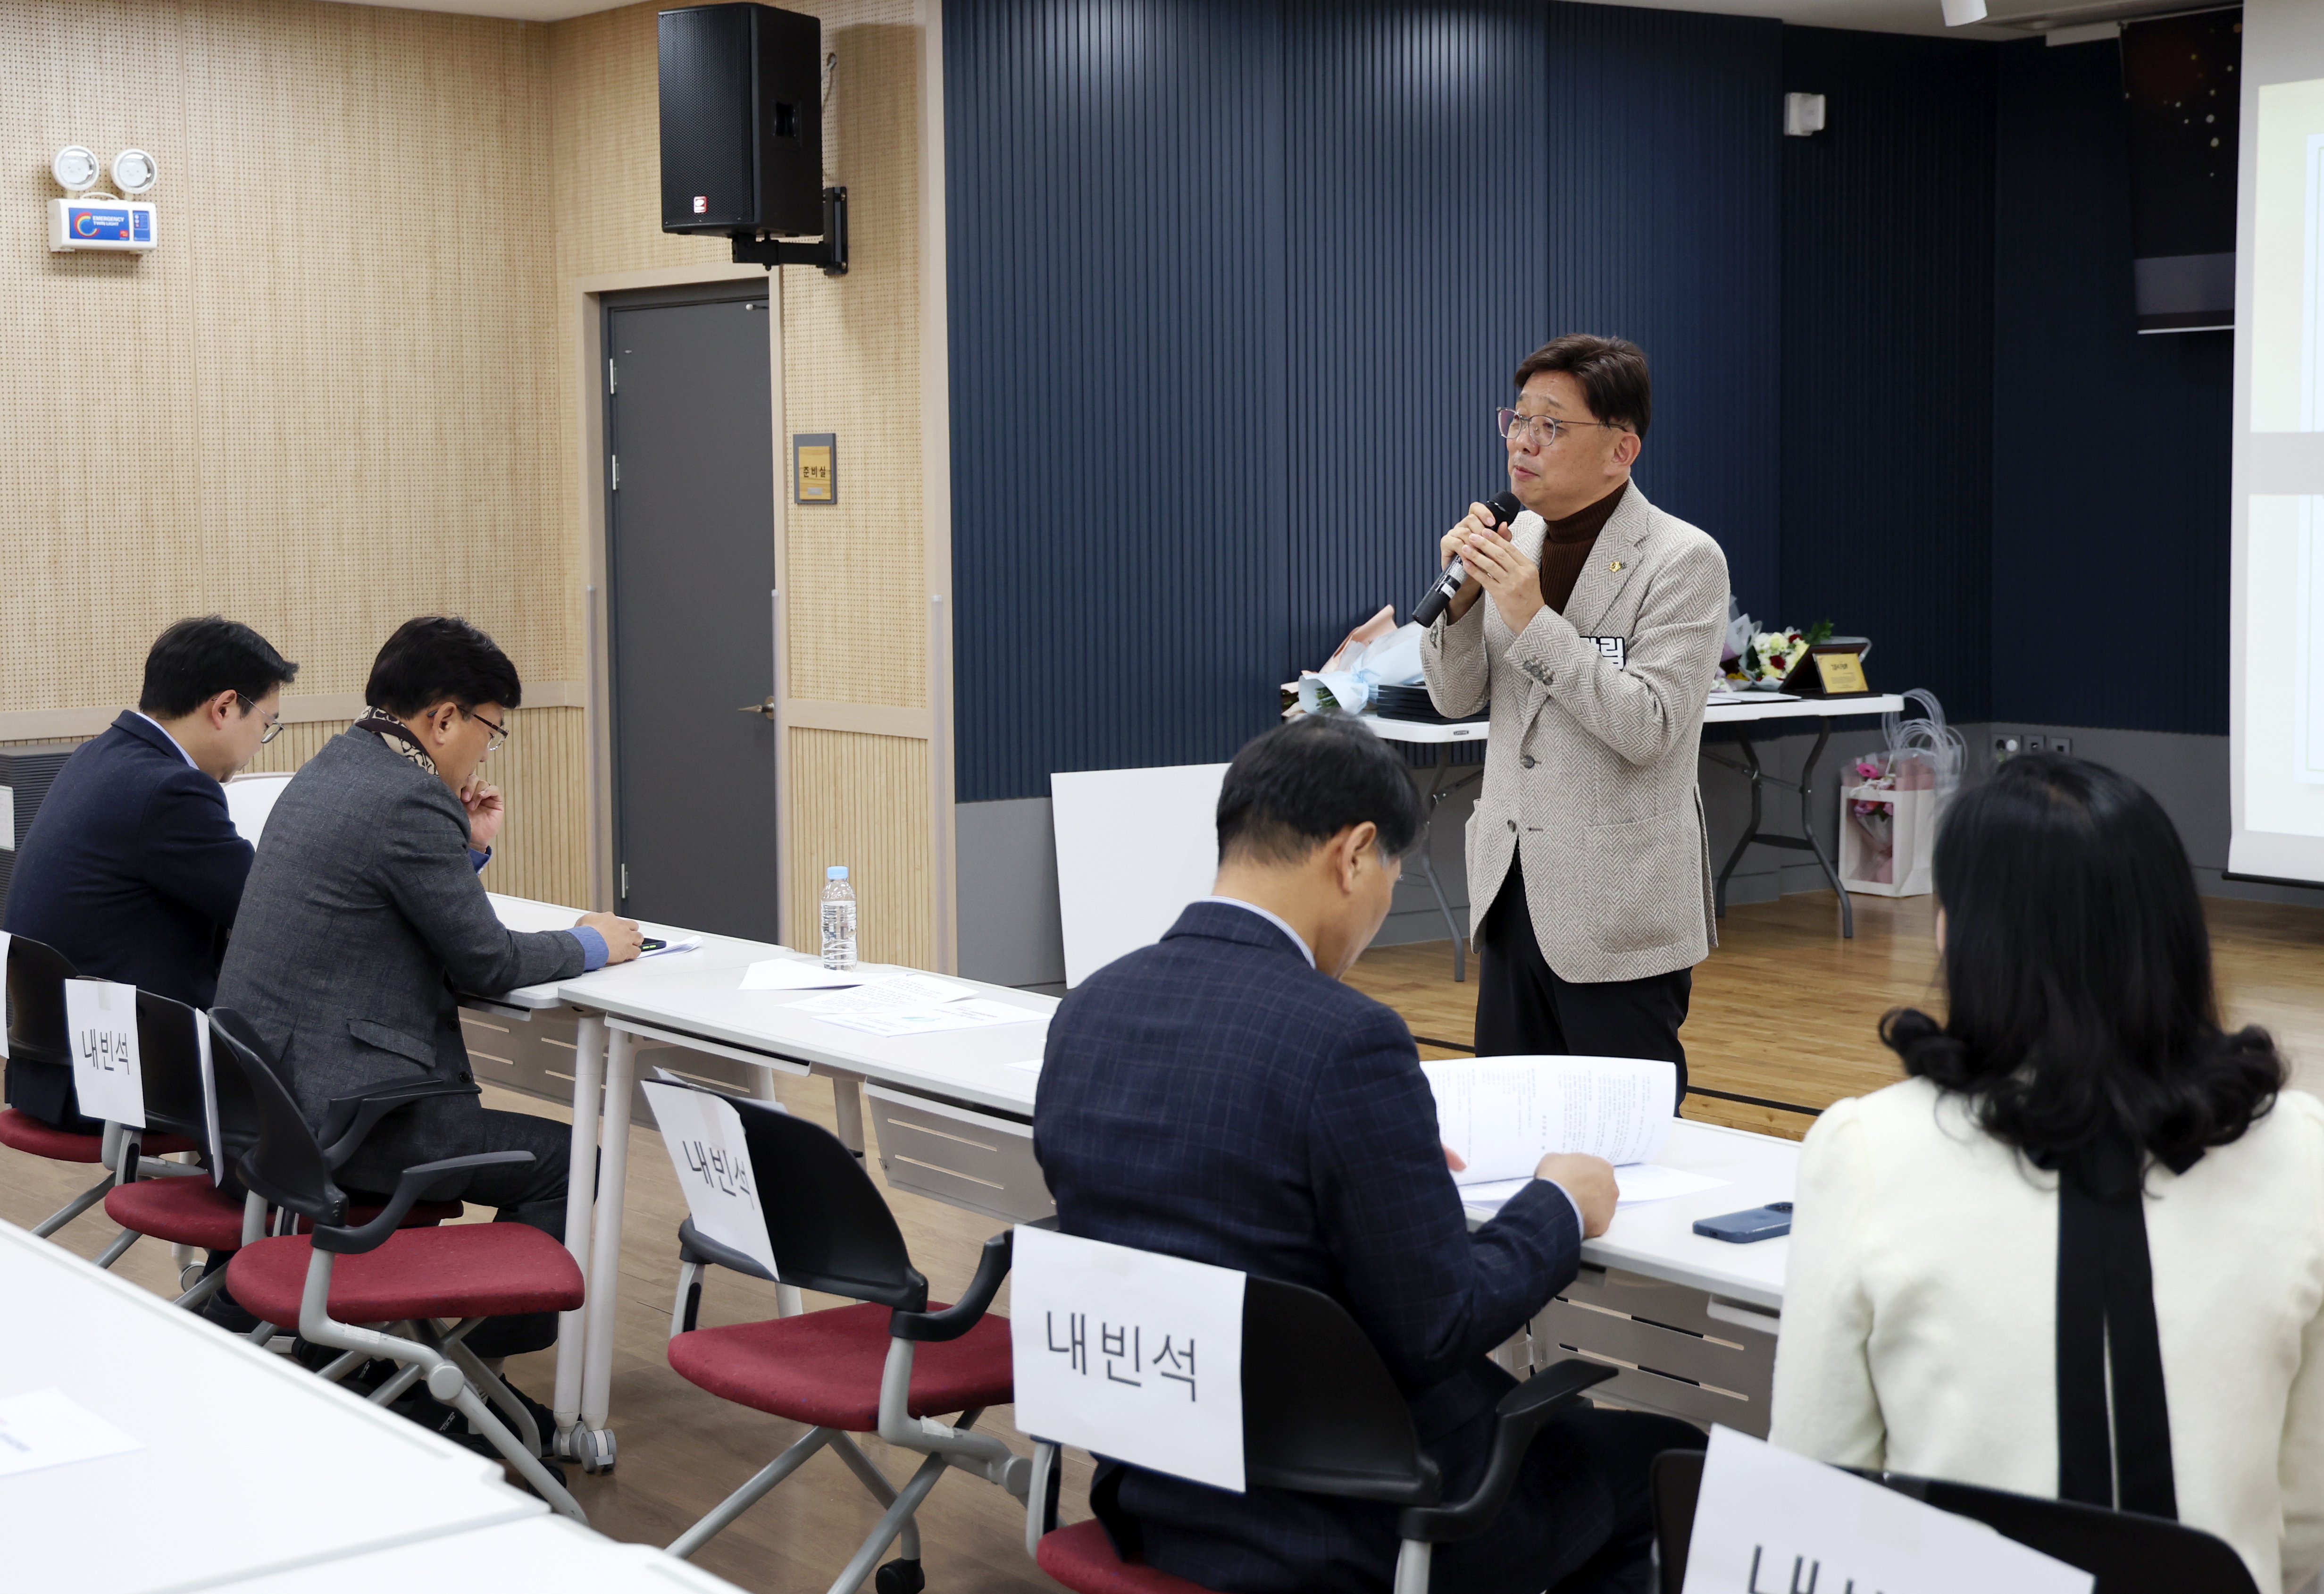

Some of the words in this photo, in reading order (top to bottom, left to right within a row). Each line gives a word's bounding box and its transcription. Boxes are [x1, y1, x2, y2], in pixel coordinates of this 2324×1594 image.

[803, 466, 826, 478] 준비실
[81, 1029, 130, 1075] 내빈석
[682, 1141, 754, 1210] 내빈석
[1046, 1310, 1197, 1403] 내빈석
